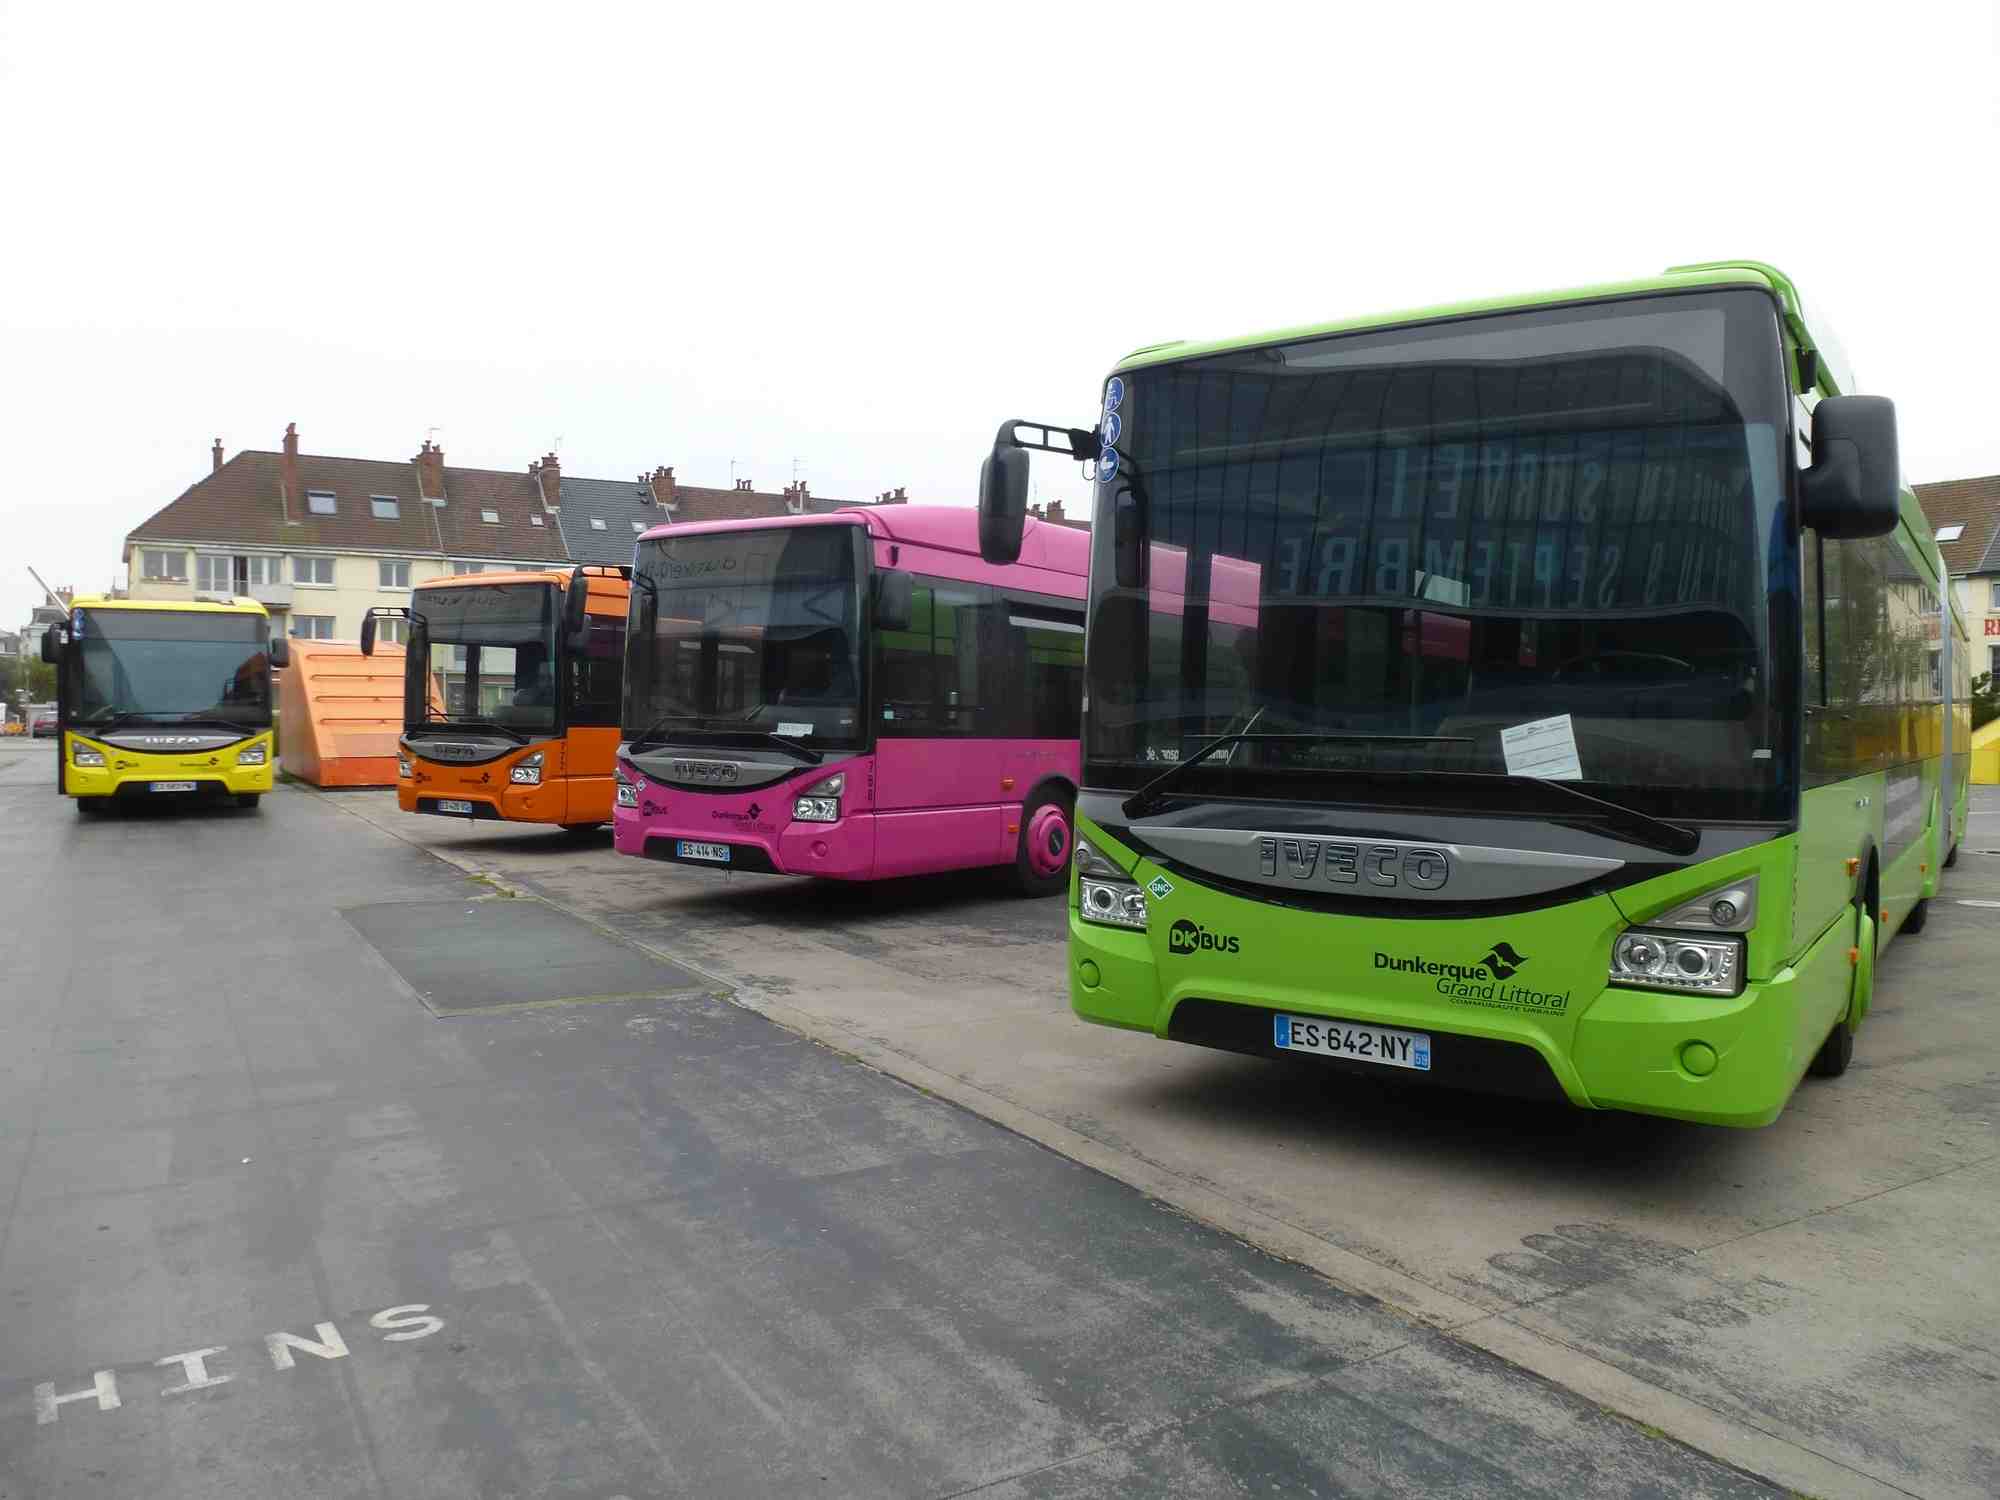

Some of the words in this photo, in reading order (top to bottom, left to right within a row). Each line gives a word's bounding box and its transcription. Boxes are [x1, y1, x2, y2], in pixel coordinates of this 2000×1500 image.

[1260, 838, 1449, 891] IVECO
[1374, 952, 1488, 983] Dunkerque
[1437, 977, 1496, 1000] Grand
[1499, 985, 1570, 1009] Littoral
[1290, 1021, 1412, 1062] ES-642-NY
[33, 1303, 446, 1425] HINS
